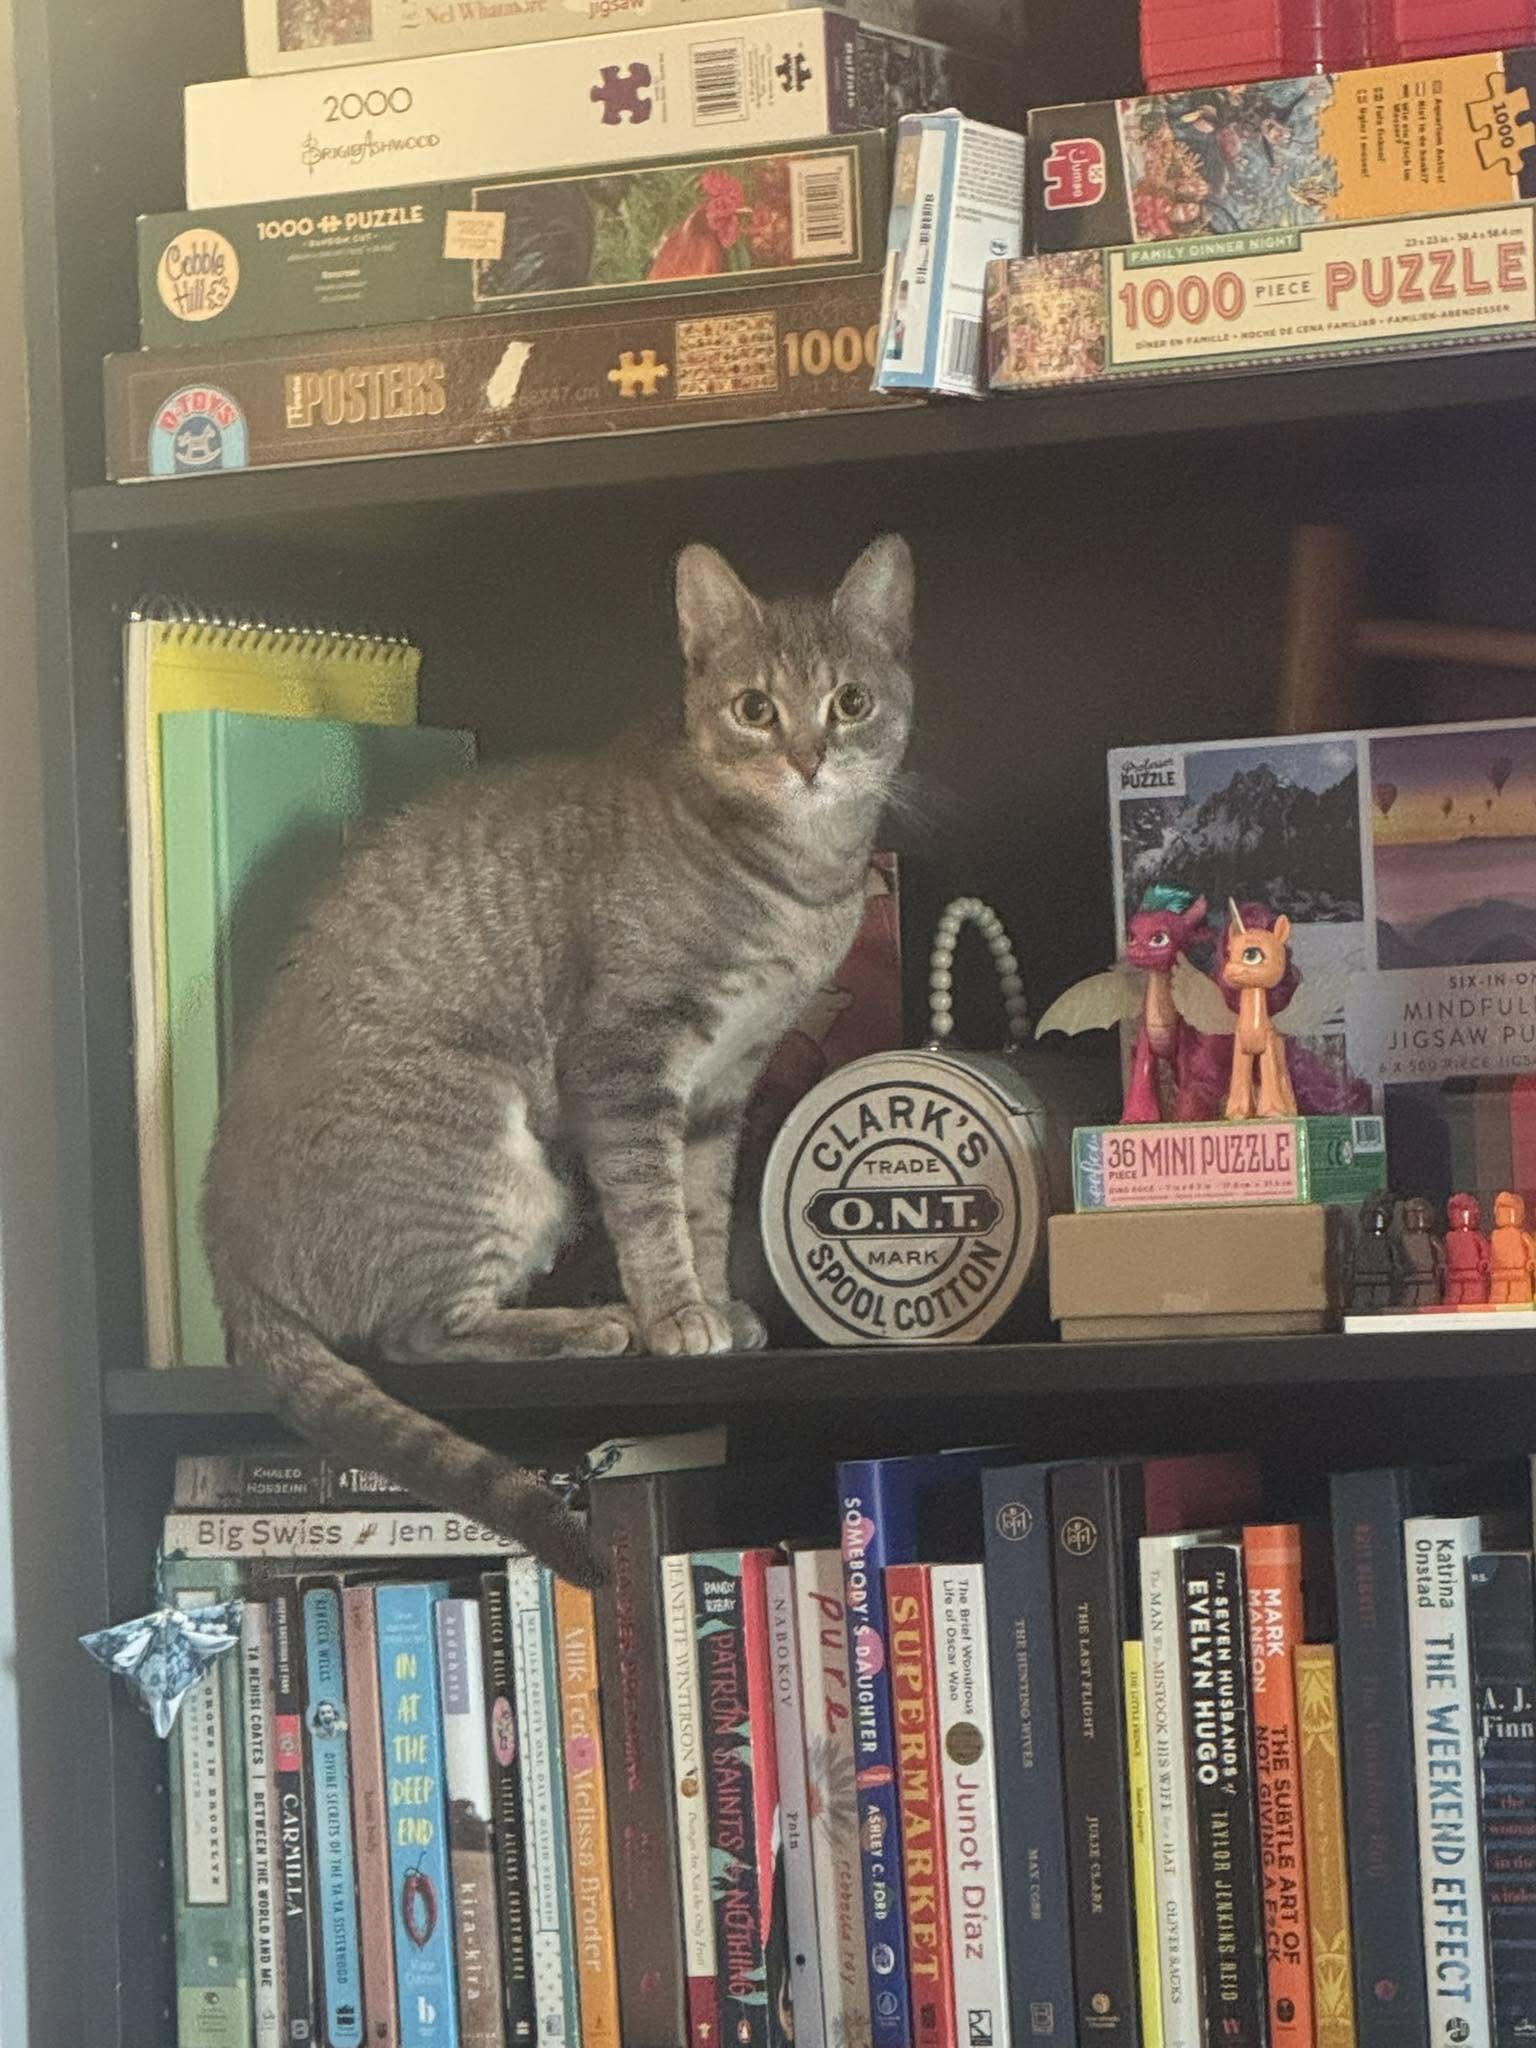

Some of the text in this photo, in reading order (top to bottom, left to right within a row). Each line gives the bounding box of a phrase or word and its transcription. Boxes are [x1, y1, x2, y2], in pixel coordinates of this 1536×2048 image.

[323, 87, 413, 122] 2000
[1492, 102, 1515, 150] 1000
[1068, 147, 1091, 198] Jumbo
[256, 205, 424, 241] 1000 PUZZLE
[1131, 233, 1294, 263] FAMILY DINNER NIGHT
[165, 244, 227, 317] Cobble Hill
[1118, 241, 1528, 331] 1000 PIECE PUZZLE
[1186, 333, 1230, 345] FAMILLE
[1280, 327, 1293, 335] DE
[1296, 324, 1323, 334] CENA
[1326, 317, 1377, 329] FAMILIAR
[1387, 304, 1510, 324] FAMILIEN-ABENDESSEN
[302, 361, 446, 426] POSTERS
[1121, 771, 1177, 789] PUZZLE
[1388, 1025, 1535, 1051] JIGSAW PU
[1404, 996, 1536, 1021] MINDFUL
[812, 1094, 989, 1173] CLARK'S
[863, 1158, 942, 1176] TRADE
[1108, 1138, 1136, 1168] 36
[1140, 1135, 1196, 1178] MINI
[1200, 1132, 1291, 1175] PUZZLE
[1108, 1169, 1137, 1180] PIECE
[828, 1195, 979, 1233] O.N.T.
[807, 1240, 1003, 1331] SPOOL COTTON
[868, 1249, 940, 1266] MARK
[247, 1482, 308, 1495] HOSSEINI
[253, 1468, 302, 1479] KHALED
[199, 1519, 433, 1550] Big Swiss Jen
[1416, 1539, 1435, 1608] Onstad
[1436, 1539, 1457, 1609] Katrina
[314, 1599, 331, 1683] REBECCA WELLS
[774, 1598, 793, 1709] NABOKOV
[844, 1497, 878, 1753] SOMEBODY'S DAUGHTER
[944, 1579, 960, 1701] Life of Oscar Wao
[959, 1579, 975, 1715] The Brief Wondrous
[1248, 1588, 1267, 1693] MANSON
[1264, 1587, 1285, 1657] MARK
[249, 1667, 262, 1710] NEHISI
[395, 1653, 417, 1681] IN
[493, 1648, 506, 1688] WELLS
[564, 1626, 593, 1739] Milk Fed
[668, 1560, 697, 1762] JEANETTE WINTERSON
[808, 1591, 850, 1734] pure
[1015, 1619, 1033, 1769] THE HUNTING WIVES
[1078, 1602, 1095, 1739] THE LAST FLIGHT
[1187, 1580, 1219, 1785] EVELYN HUGO
[1214, 1596, 1238, 1777] SEVEN HUSBANDS
[397, 1694, 420, 1723] AT
[530, 1681, 542, 1733] PRETTY
[1149, 1592, 1177, 1877] MAN MISTOOK HIS WIFE HAT
[1482, 1716, 1534, 1738] Finn
[1483, 1686, 1533, 1713] A. J.
[251, 1714, 263, 1765] COATES
[392, 1734, 429, 1765] THE
[535, 1740, 544, 1765] ONE
[392, 1776, 433, 1806] DEEP
[537, 1773, 546, 1799] DAY
[709, 1631, 754, 1997] PATRON SAINTS NOTHING
[892, 1595, 940, 1982] SUPERMARKET
[1256, 1725, 1275, 1890] NOT GIVING A
[1425, 1633, 1473, 2004] THE WEEKEND EFFECT
[208, 1788, 219, 1886] BROOKLYN
[282, 1793, 303, 1917] CARMILLA
[397, 1817, 433, 1847] END
[867, 1804, 888, 1921] ASHLEY C. FORD
[956, 1773, 989, 1960] Junot Díaz
[1086, 1816, 1103, 1913] JULIE CLARK
[1270, 1725, 1301, 1965] THE SUBTLE ART OF
[254, 1791, 272, 1987] BETWEEN THE WORLD AND ME
[324, 1752, 348, 1985] DIVINE SECRETS OF THE YA-YA SISTERHOOD
[574, 1766, 603, 1973] Melissa Broder
[461, 1882, 482, 2000] kira-kira
[1211, 1810, 1239, 2001] TAYLOR JENKINS REID
[1165, 1900, 1183, 2005] OLIVER SACKS
